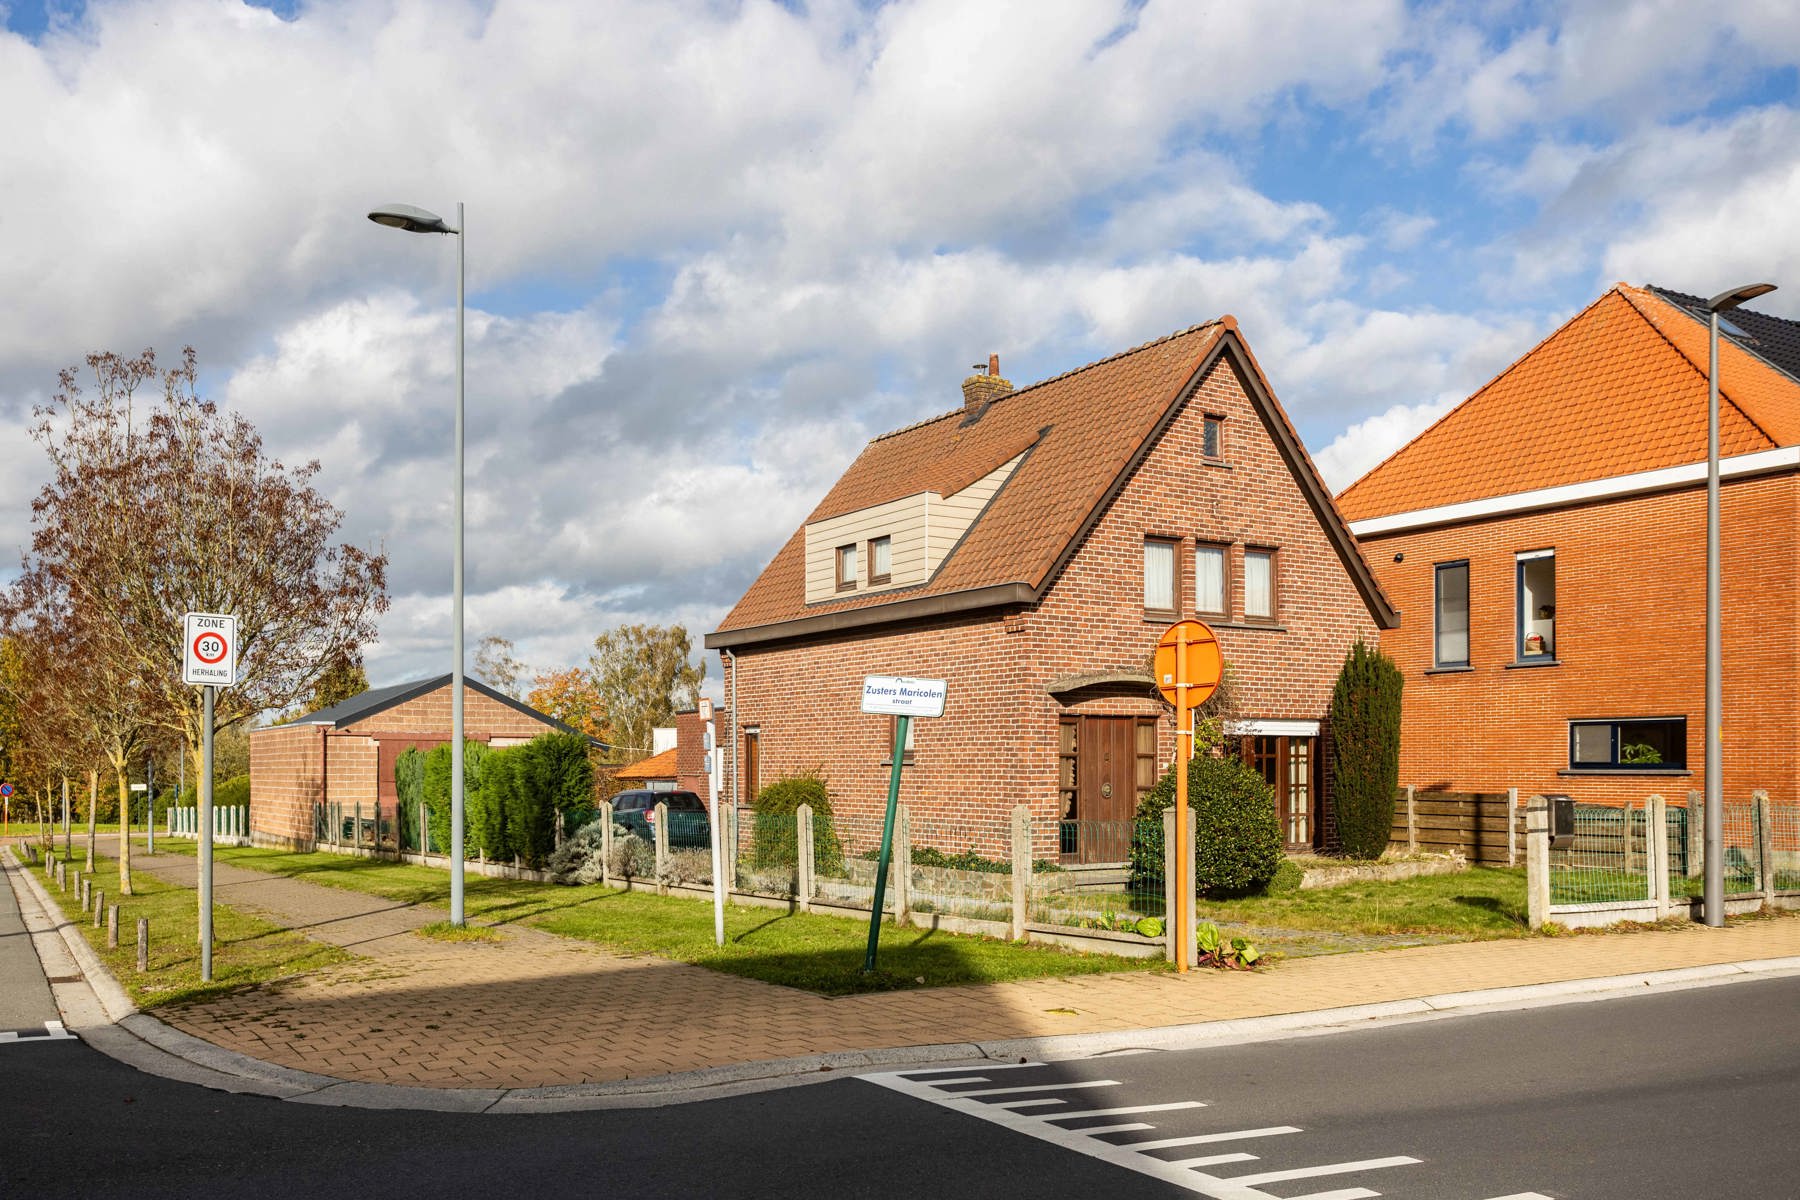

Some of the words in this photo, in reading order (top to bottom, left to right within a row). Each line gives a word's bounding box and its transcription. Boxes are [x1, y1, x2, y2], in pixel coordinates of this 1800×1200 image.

[197, 618, 225, 628] ZONE
[202, 641, 219, 652] 30
[193, 668, 227, 677] HERHALING
[866, 685, 897, 696] Zusters
[899, 688, 942, 698] Maricolen
